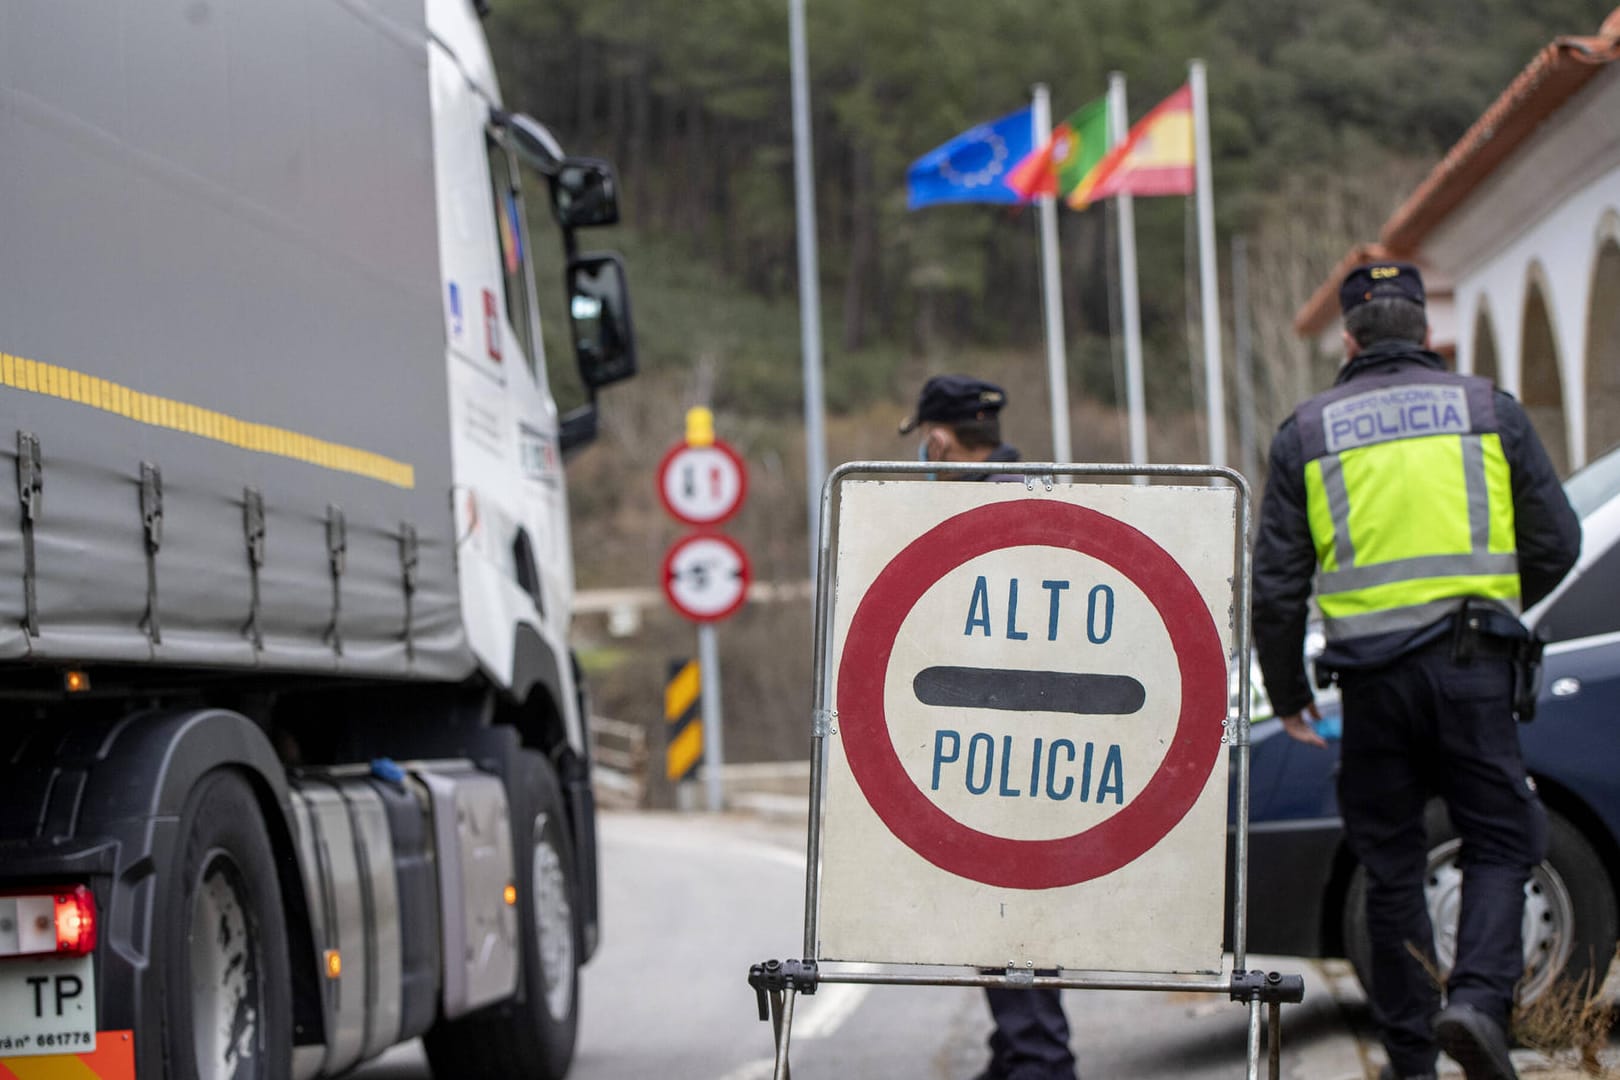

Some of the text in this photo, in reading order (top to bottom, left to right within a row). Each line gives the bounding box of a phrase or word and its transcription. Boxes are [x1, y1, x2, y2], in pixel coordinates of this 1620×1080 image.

[1331, 404, 1463, 446] POLICIA
[964, 575, 1115, 645] ALTO
[931, 730, 1124, 805] POLICIA
[26, 974, 83, 1018] TP
[36, 1032, 91, 1047] 661778
